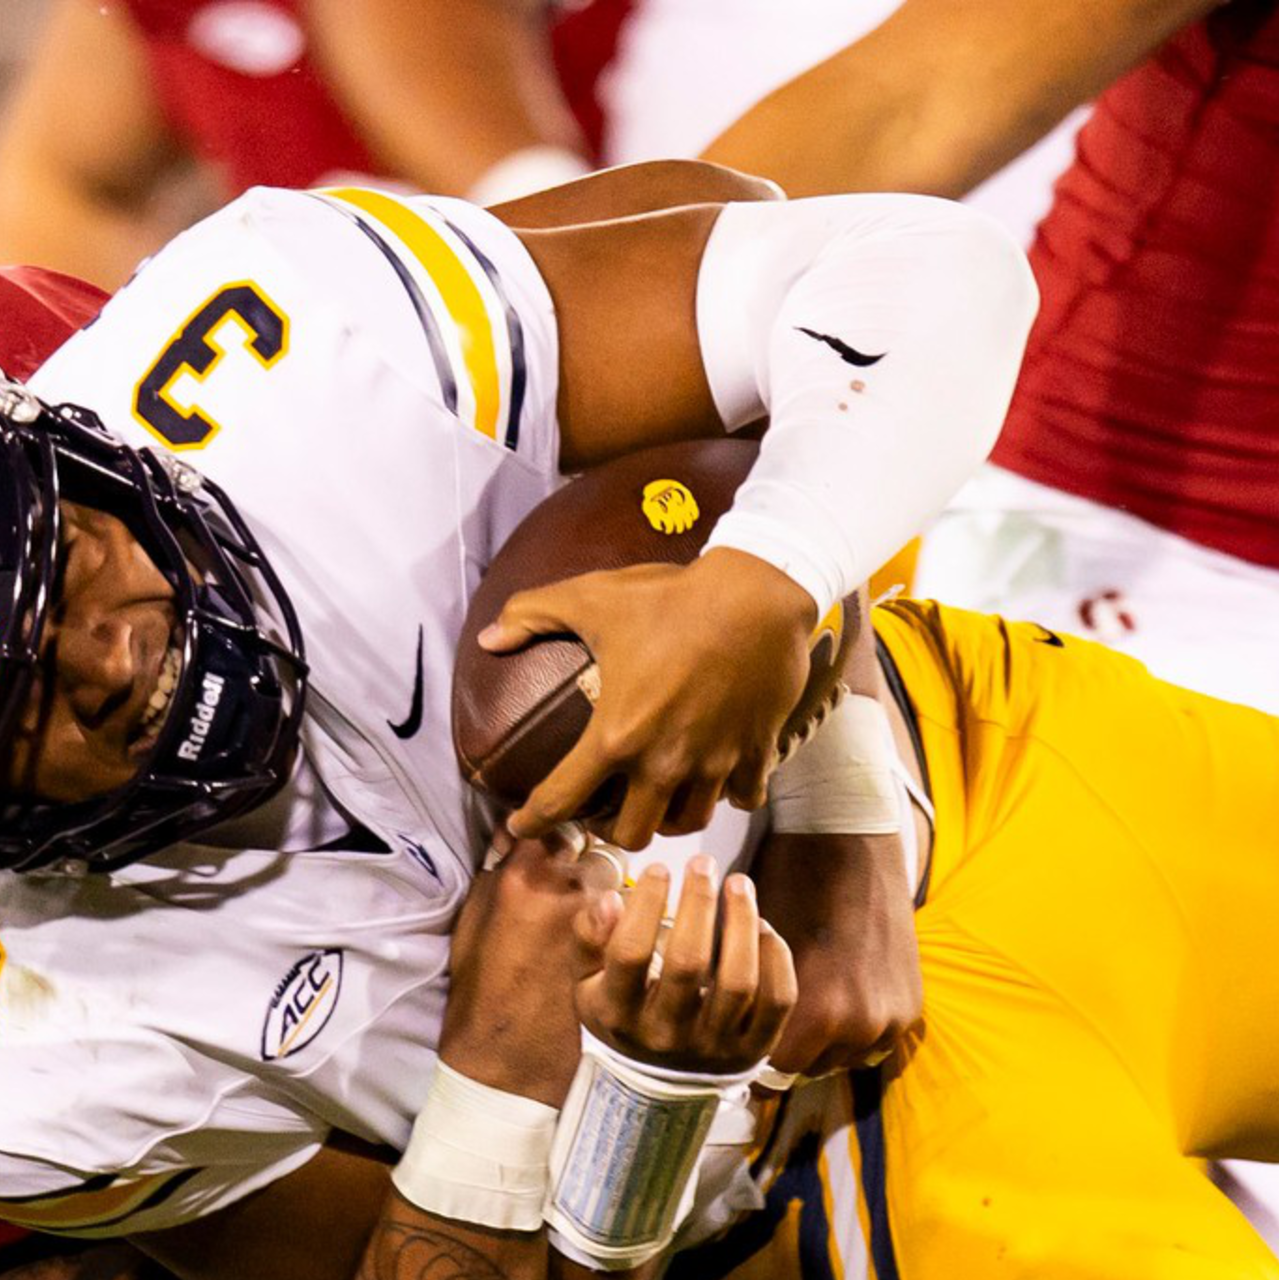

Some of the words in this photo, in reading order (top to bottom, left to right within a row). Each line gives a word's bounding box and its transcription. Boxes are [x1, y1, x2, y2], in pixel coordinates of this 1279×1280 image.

[130, 278, 291, 452] 3
[177, 671, 226, 761] Riddell
[279, 955, 331, 1046] ACC
